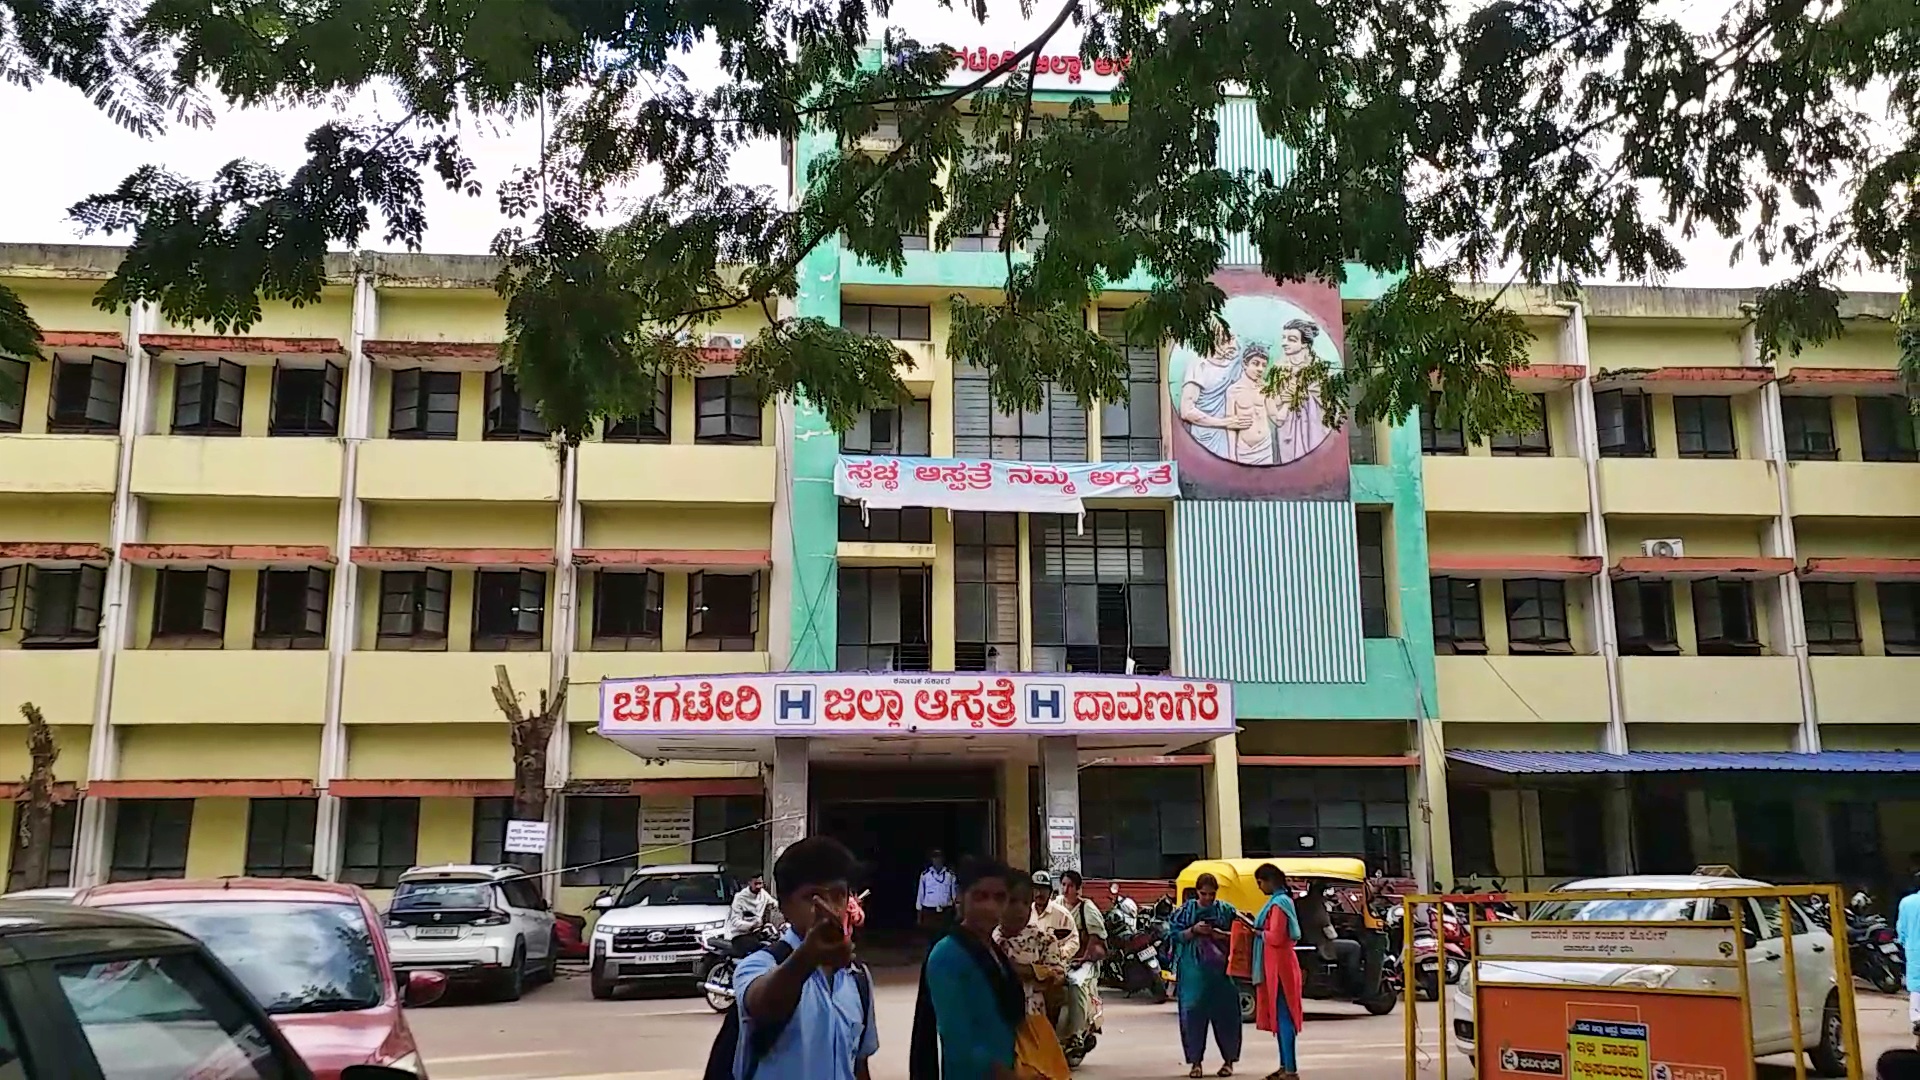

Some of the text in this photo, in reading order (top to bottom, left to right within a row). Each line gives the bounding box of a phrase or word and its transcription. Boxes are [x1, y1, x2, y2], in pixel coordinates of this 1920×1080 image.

[915, 462, 992, 491] ಆಸ್ಪತ್ರೆ
[1008, 464, 1076, 494] ನಮ್ಮ
[1089, 464, 1172, 494] ಆದ್ಯತೆ
[824, 687, 903, 727] ಜಿಲ್ಲಾ
[914, 679, 1017, 728] ಆಸ್ಪತ್ರೆ
[1073, 682, 1219, 721] ದಾವಣಗೆರೆ
